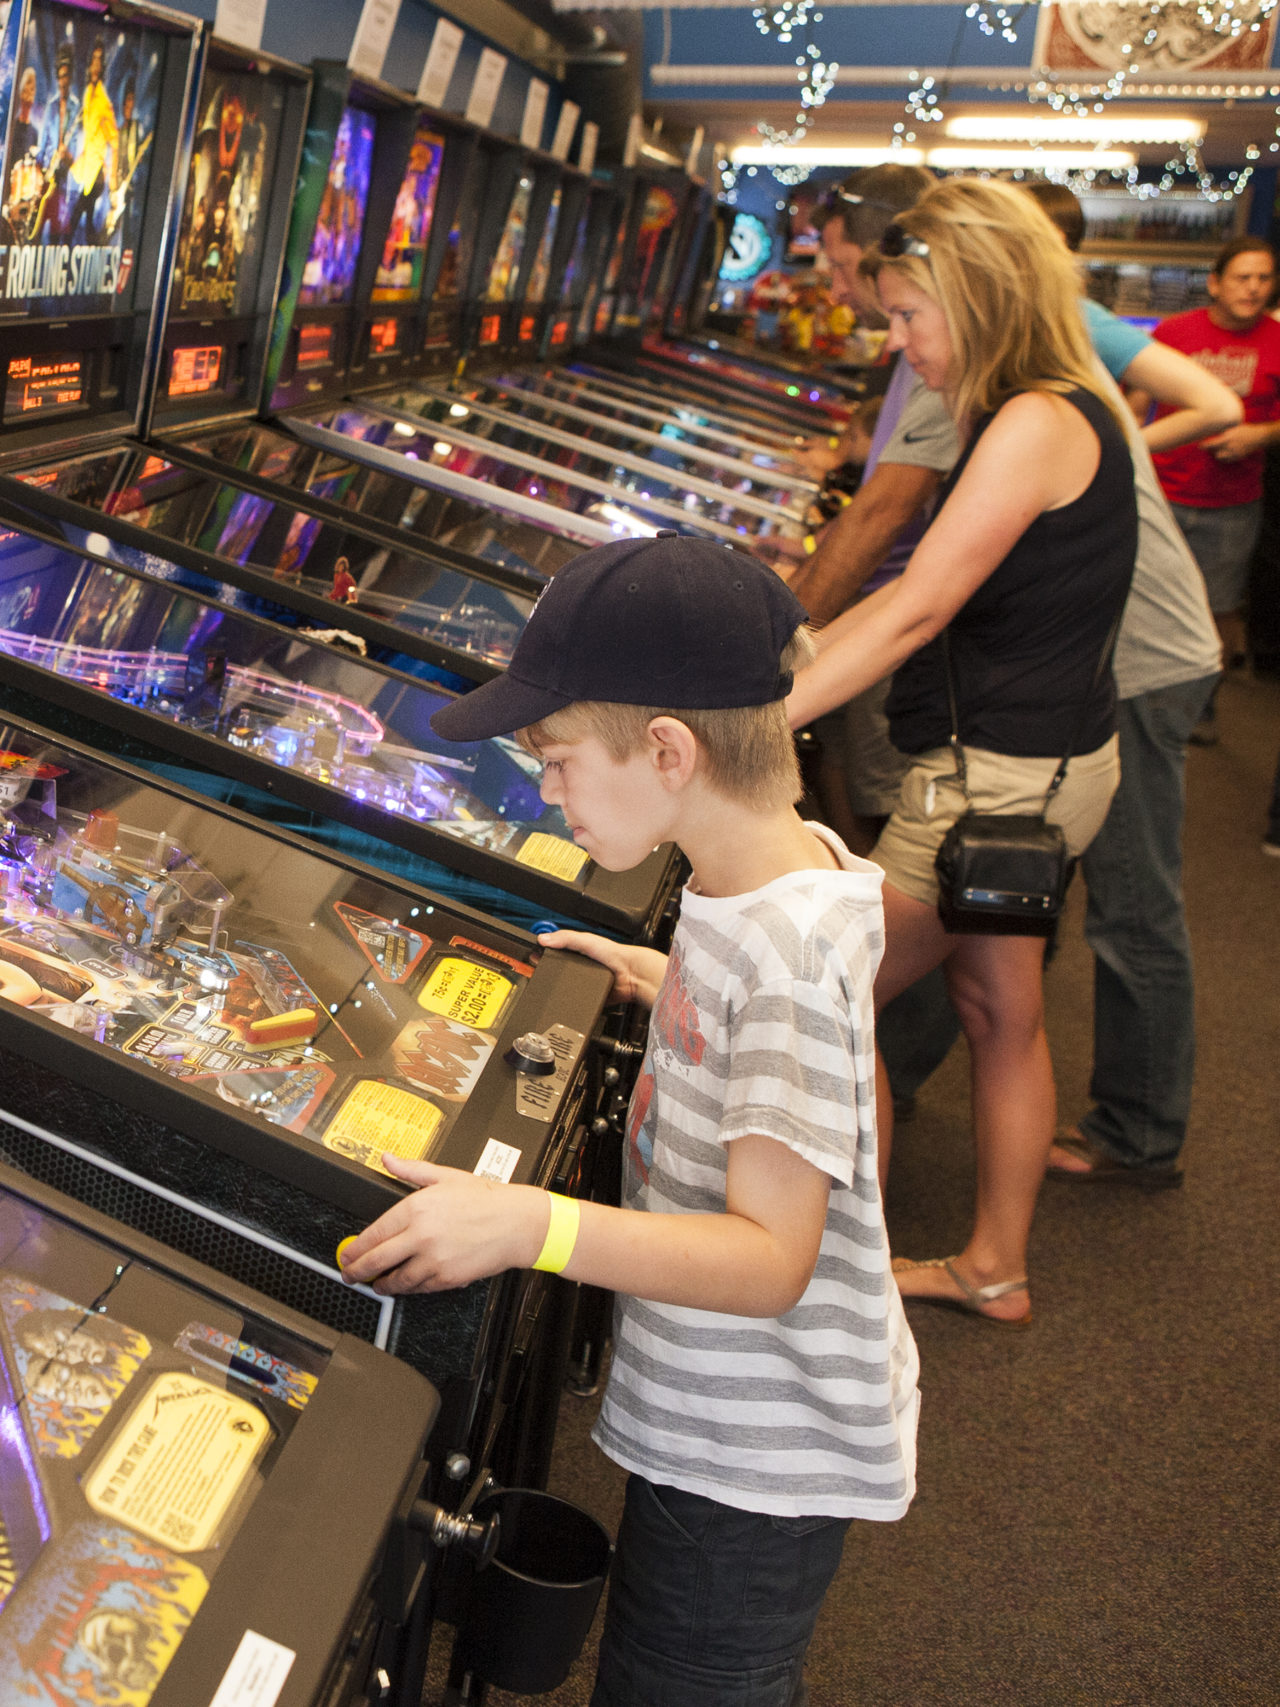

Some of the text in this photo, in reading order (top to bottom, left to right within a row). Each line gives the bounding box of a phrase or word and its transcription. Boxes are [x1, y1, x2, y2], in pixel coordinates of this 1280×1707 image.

[6, 244, 70, 298] ROLLING
[68, 244, 121, 295] STONES
[448, 967, 485, 1018] SUPER VALUE
[520, 1078, 555, 1110] FIRE
